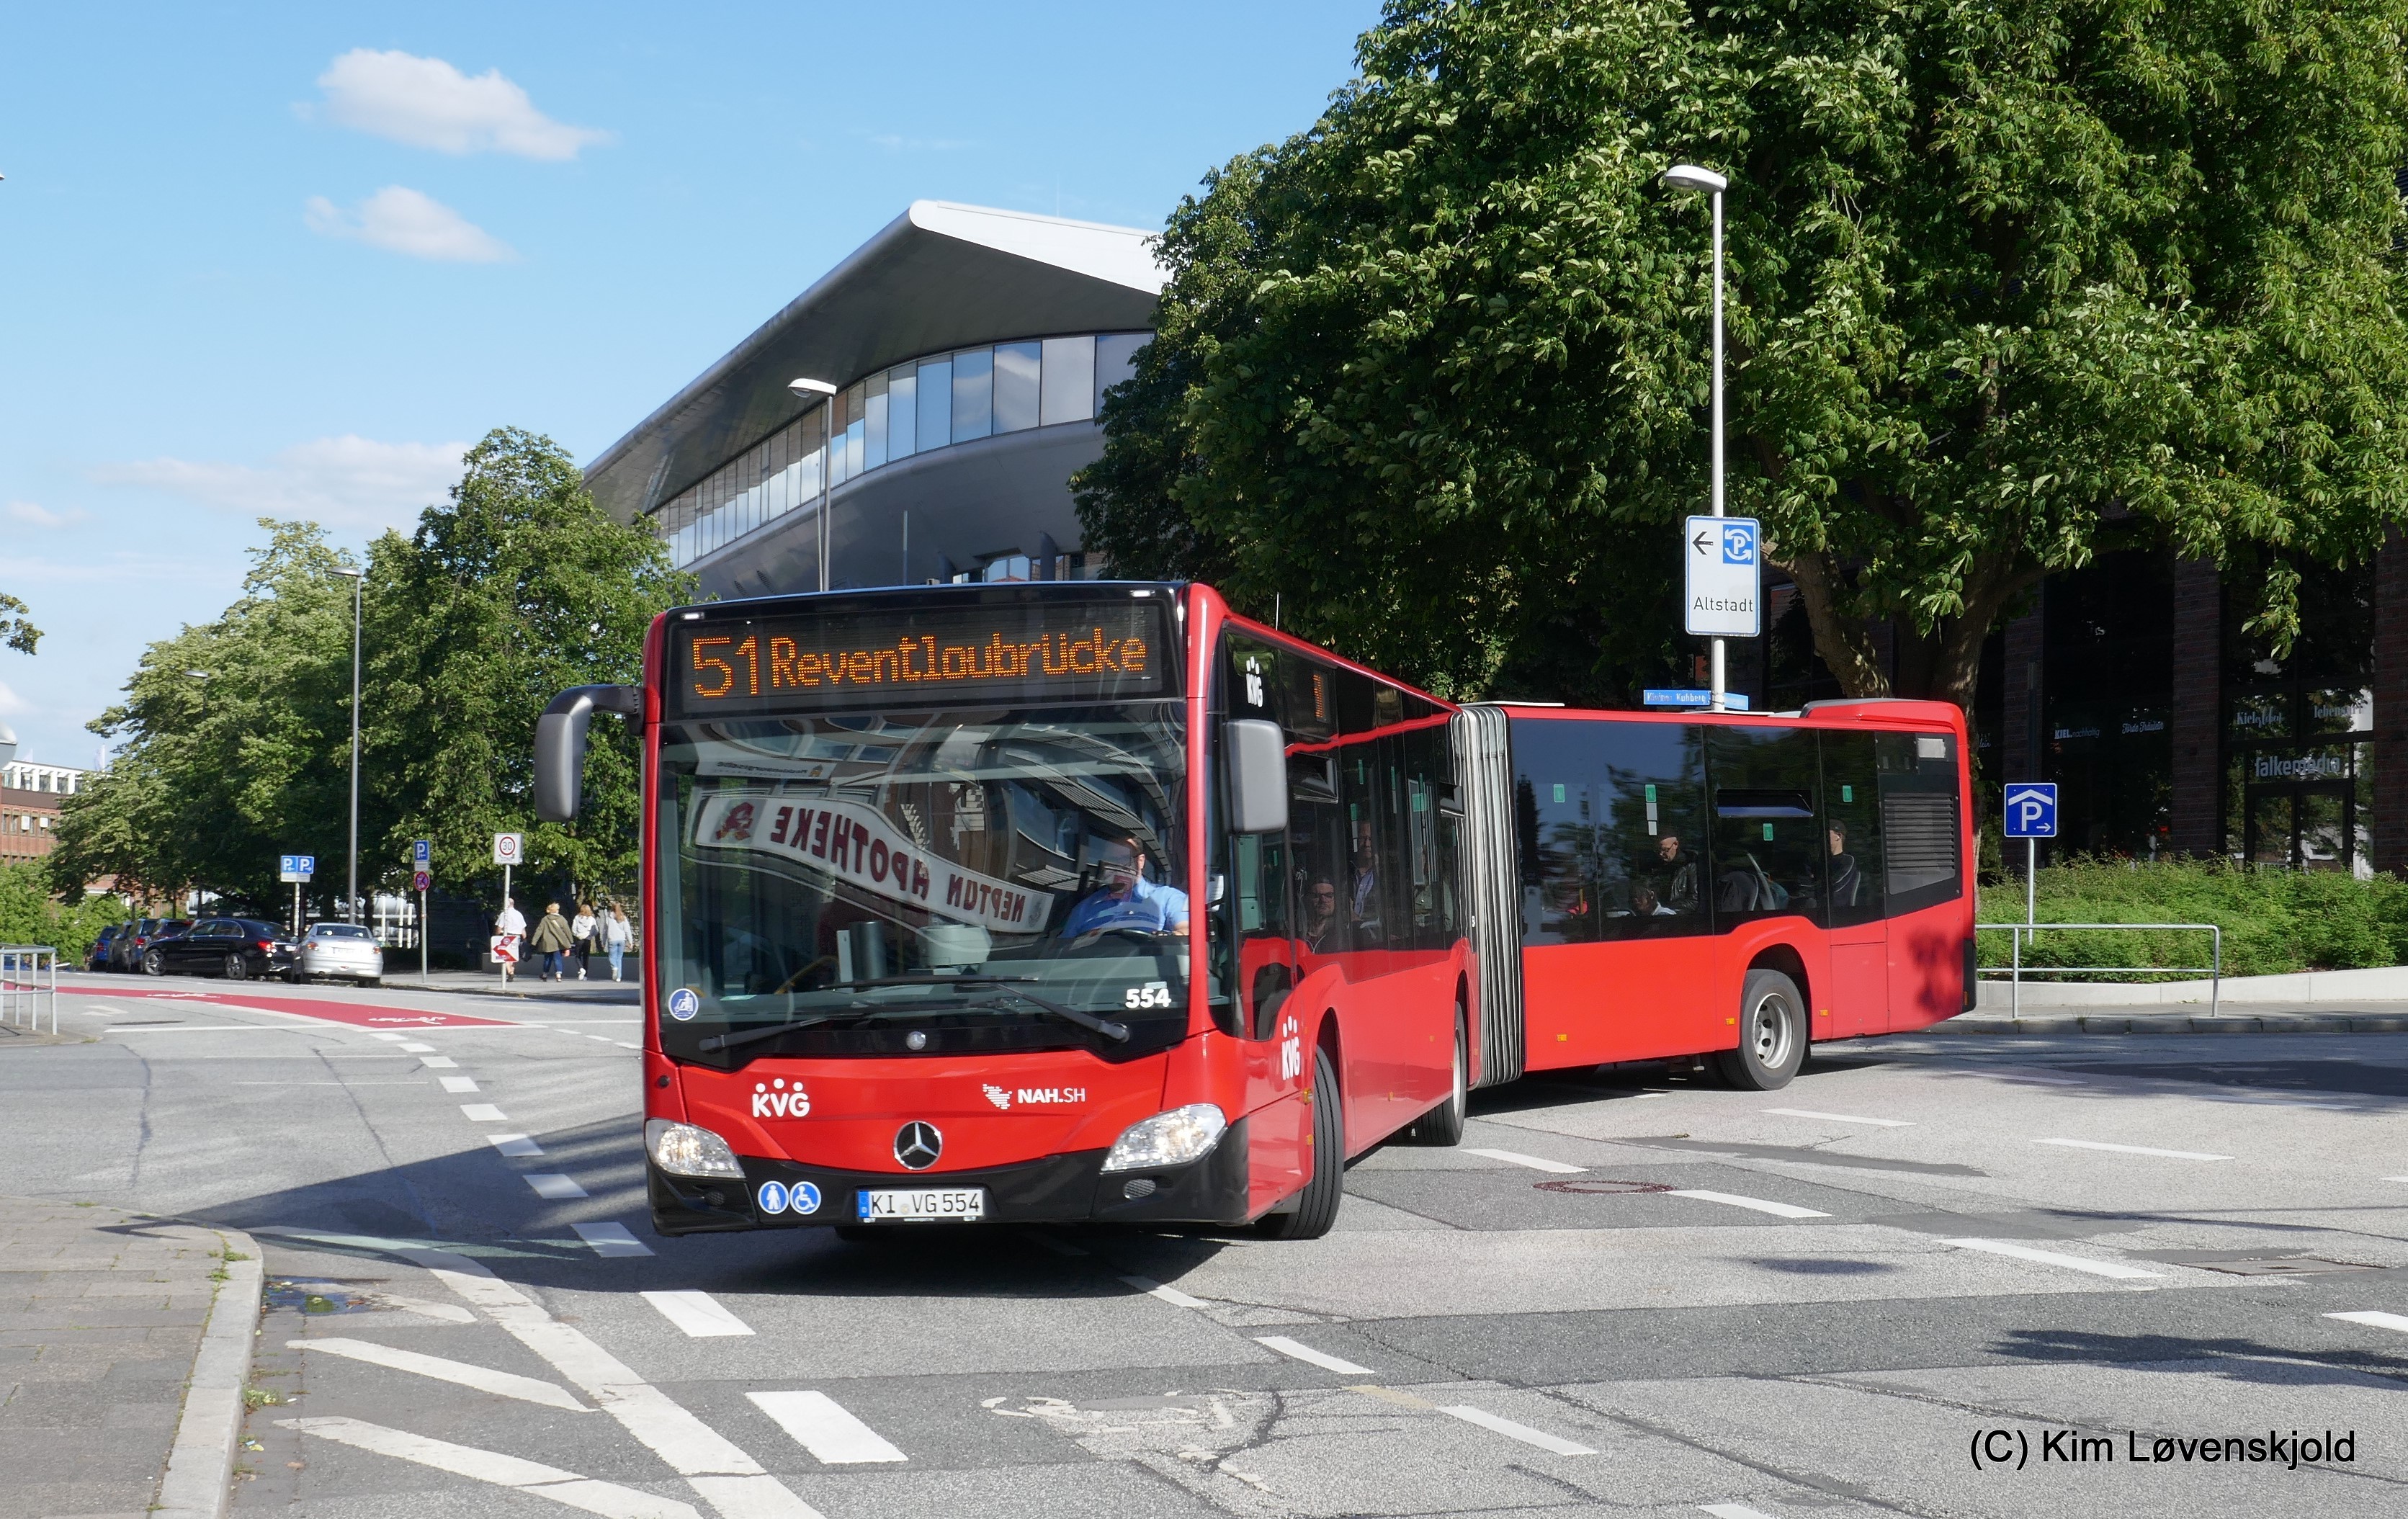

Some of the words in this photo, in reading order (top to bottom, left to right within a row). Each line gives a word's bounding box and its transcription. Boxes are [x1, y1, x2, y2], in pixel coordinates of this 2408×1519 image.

[1693, 596, 1753, 612] Altstadt
[691, 635, 759, 697] 51
[771, 628, 1147, 688] Reventloubrücke
[1245, 673, 1263, 708] KVG
[1676, 693, 1706, 704] Kuhberg
[2255, 752, 2340, 778] falkemedia
[2021, 802, 2042, 831] P
[503, 841, 512, 851] 30
[283, 858, 293, 871] P
[300, 859, 310, 871] P
[1125, 987, 1172, 1009] 554
[1281, 1036, 1300, 1081] KVG
[752, 1090, 810, 1118] KVG
[1017, 1087, 1086, 1104] NAH.SH
[871, 1194, 895, 1214] KI
[911, 1193, 937, 1213] VG
[942, 1193, 980, 1213] 554
